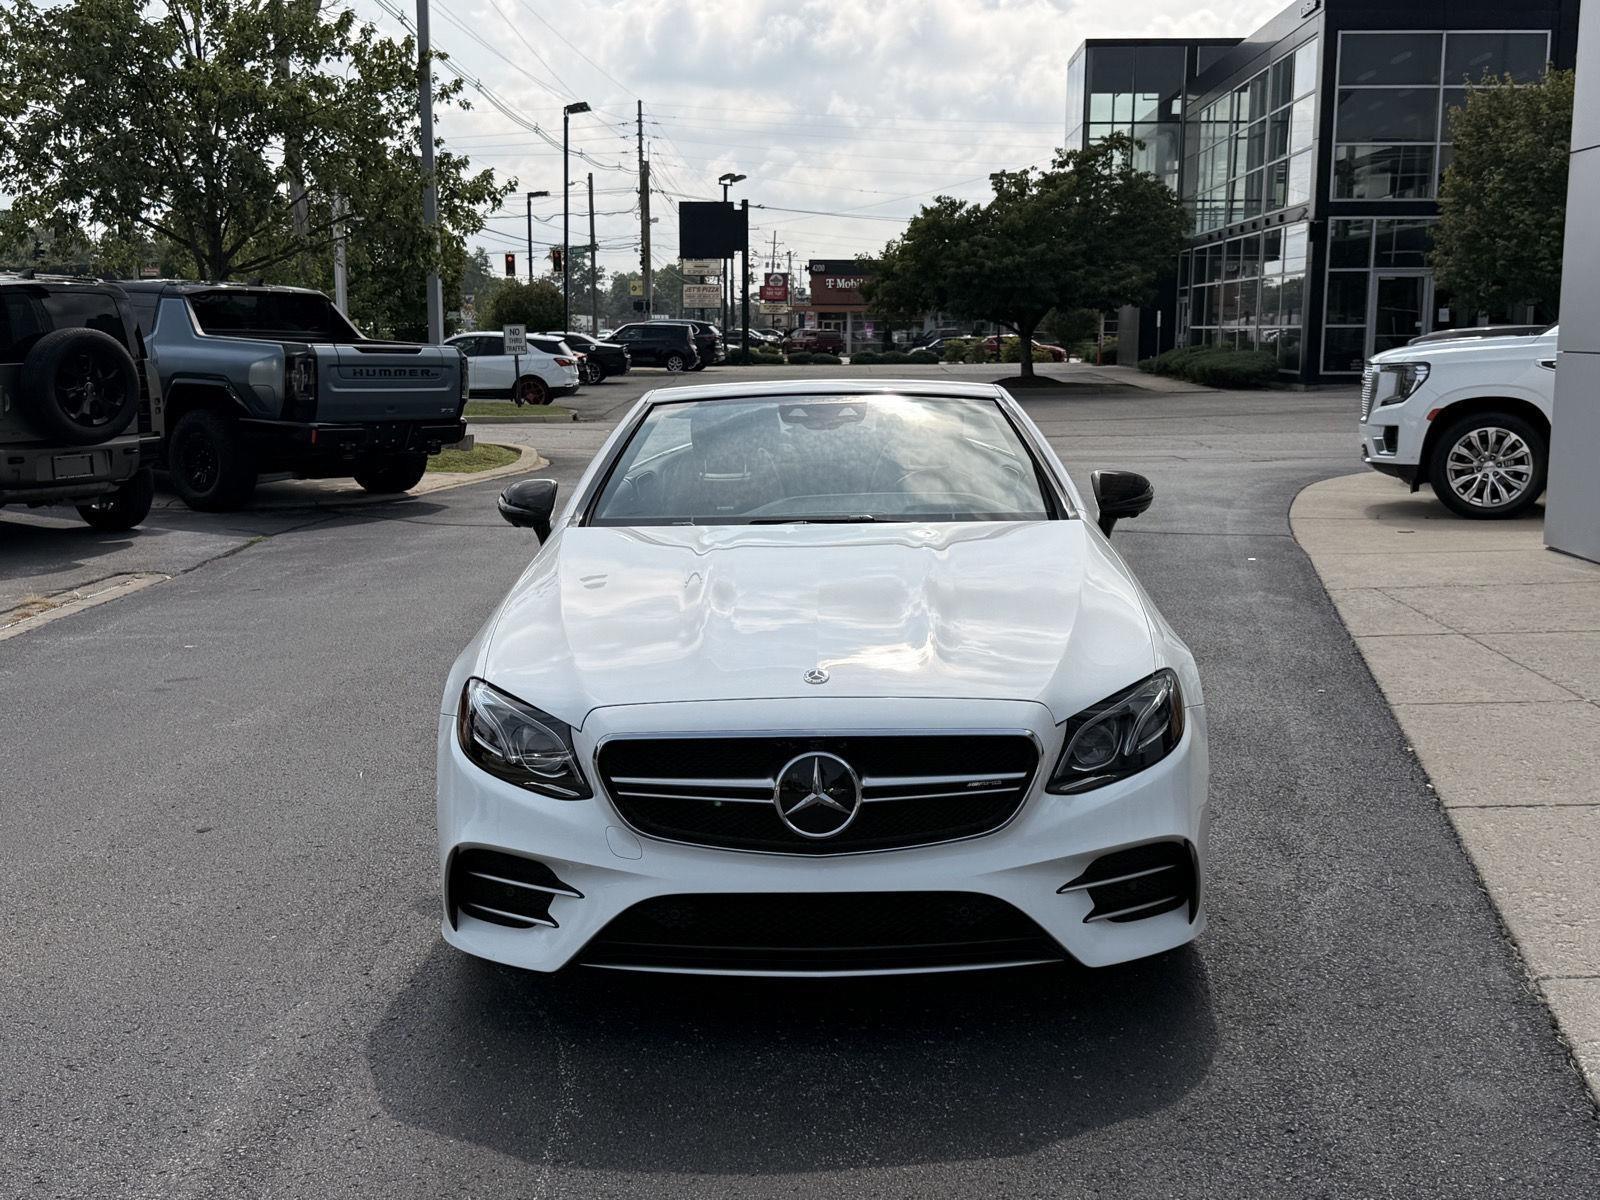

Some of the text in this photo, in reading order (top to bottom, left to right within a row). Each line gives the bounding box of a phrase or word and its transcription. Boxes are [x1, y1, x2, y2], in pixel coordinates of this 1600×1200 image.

[836, 278, 863, 288] Mobi
[509, 328, 520, 336] NO
[352, 368, 430, 377] HUMMER
